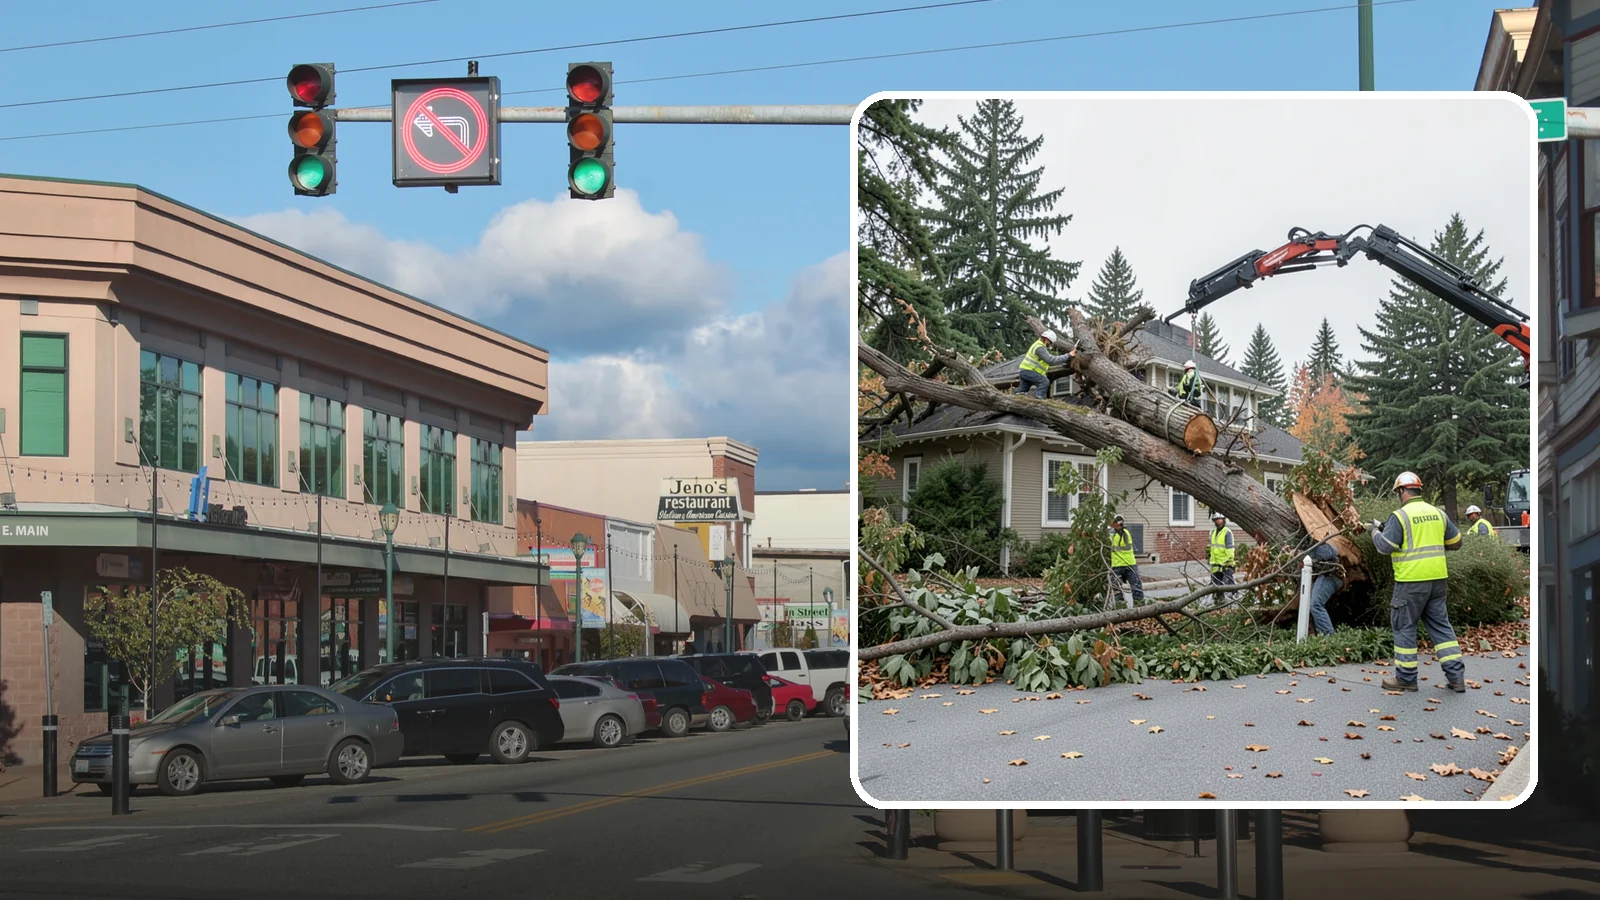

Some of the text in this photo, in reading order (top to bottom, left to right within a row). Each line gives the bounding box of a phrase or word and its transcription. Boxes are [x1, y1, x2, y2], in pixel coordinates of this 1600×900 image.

[669, 480, 727, 494] Jeno's
[665, 496, 731, 509] restaurant
[658, 510, 682, 519] Italian
[686, 510, 714, 519] American
[714, 510, 737, 519] Cuisine
[2, 525, 49, 536] E. MAIN
[797, 607, 829, 617] Street
[790, 619, 823, 627] lass
